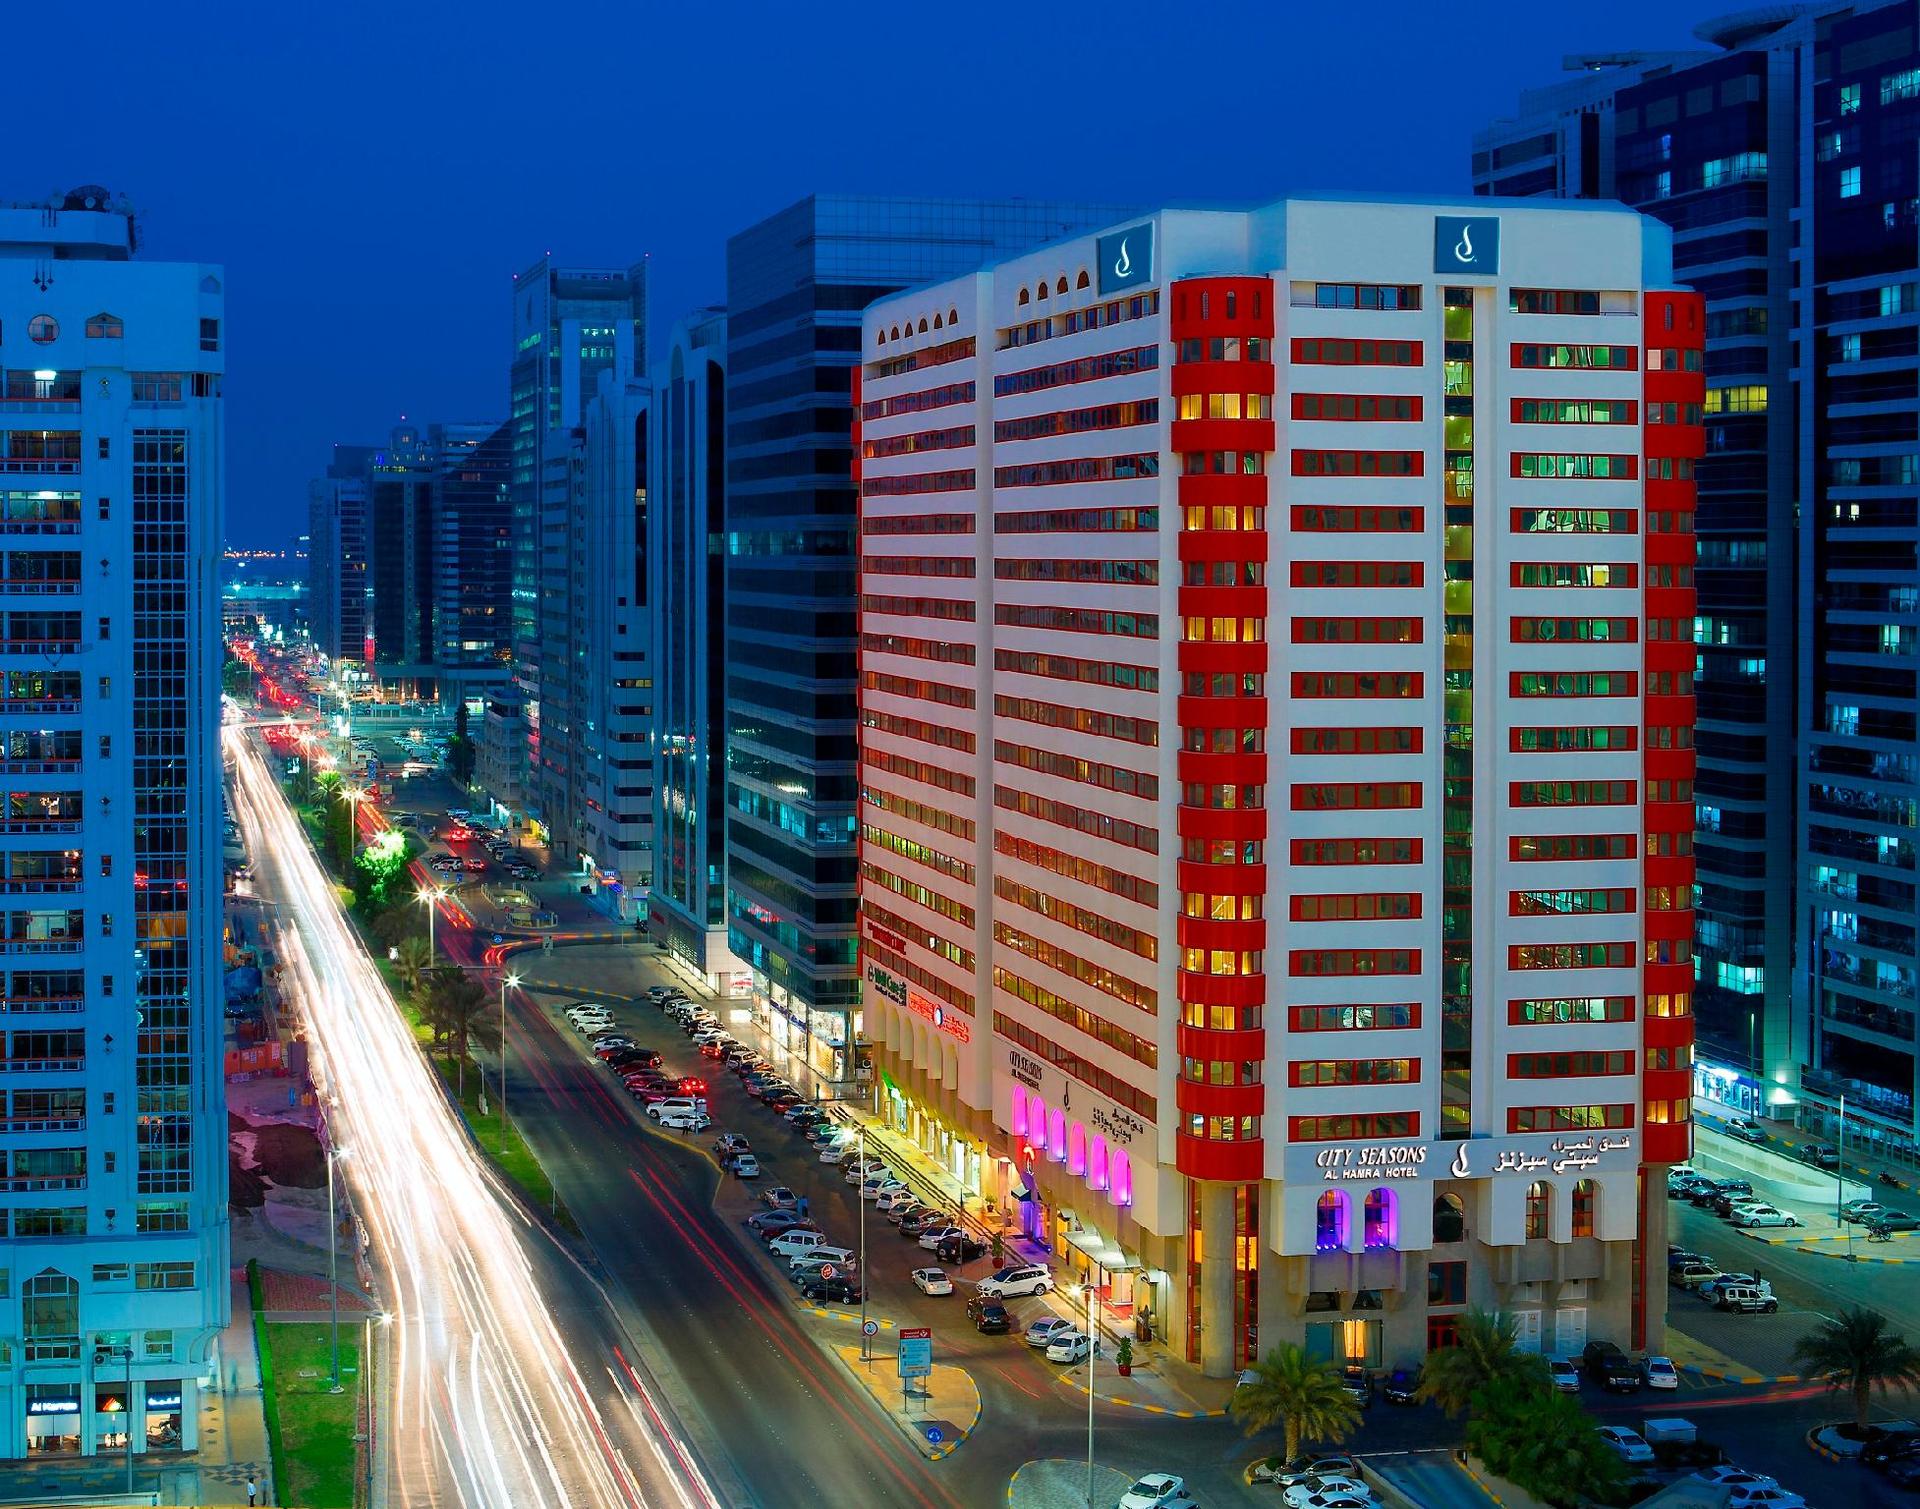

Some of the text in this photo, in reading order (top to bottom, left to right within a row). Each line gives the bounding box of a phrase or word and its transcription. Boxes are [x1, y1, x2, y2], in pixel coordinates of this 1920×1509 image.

[1598, 1134, 1630, 1152] فندق
[1316, 1146, 1427, 1168] CITY SEASONS
[1493, 1152, 1599, 1174] سيتي سيزنز
[1323, 1167, 1418, 1180] AL HAMRA HOTEL
